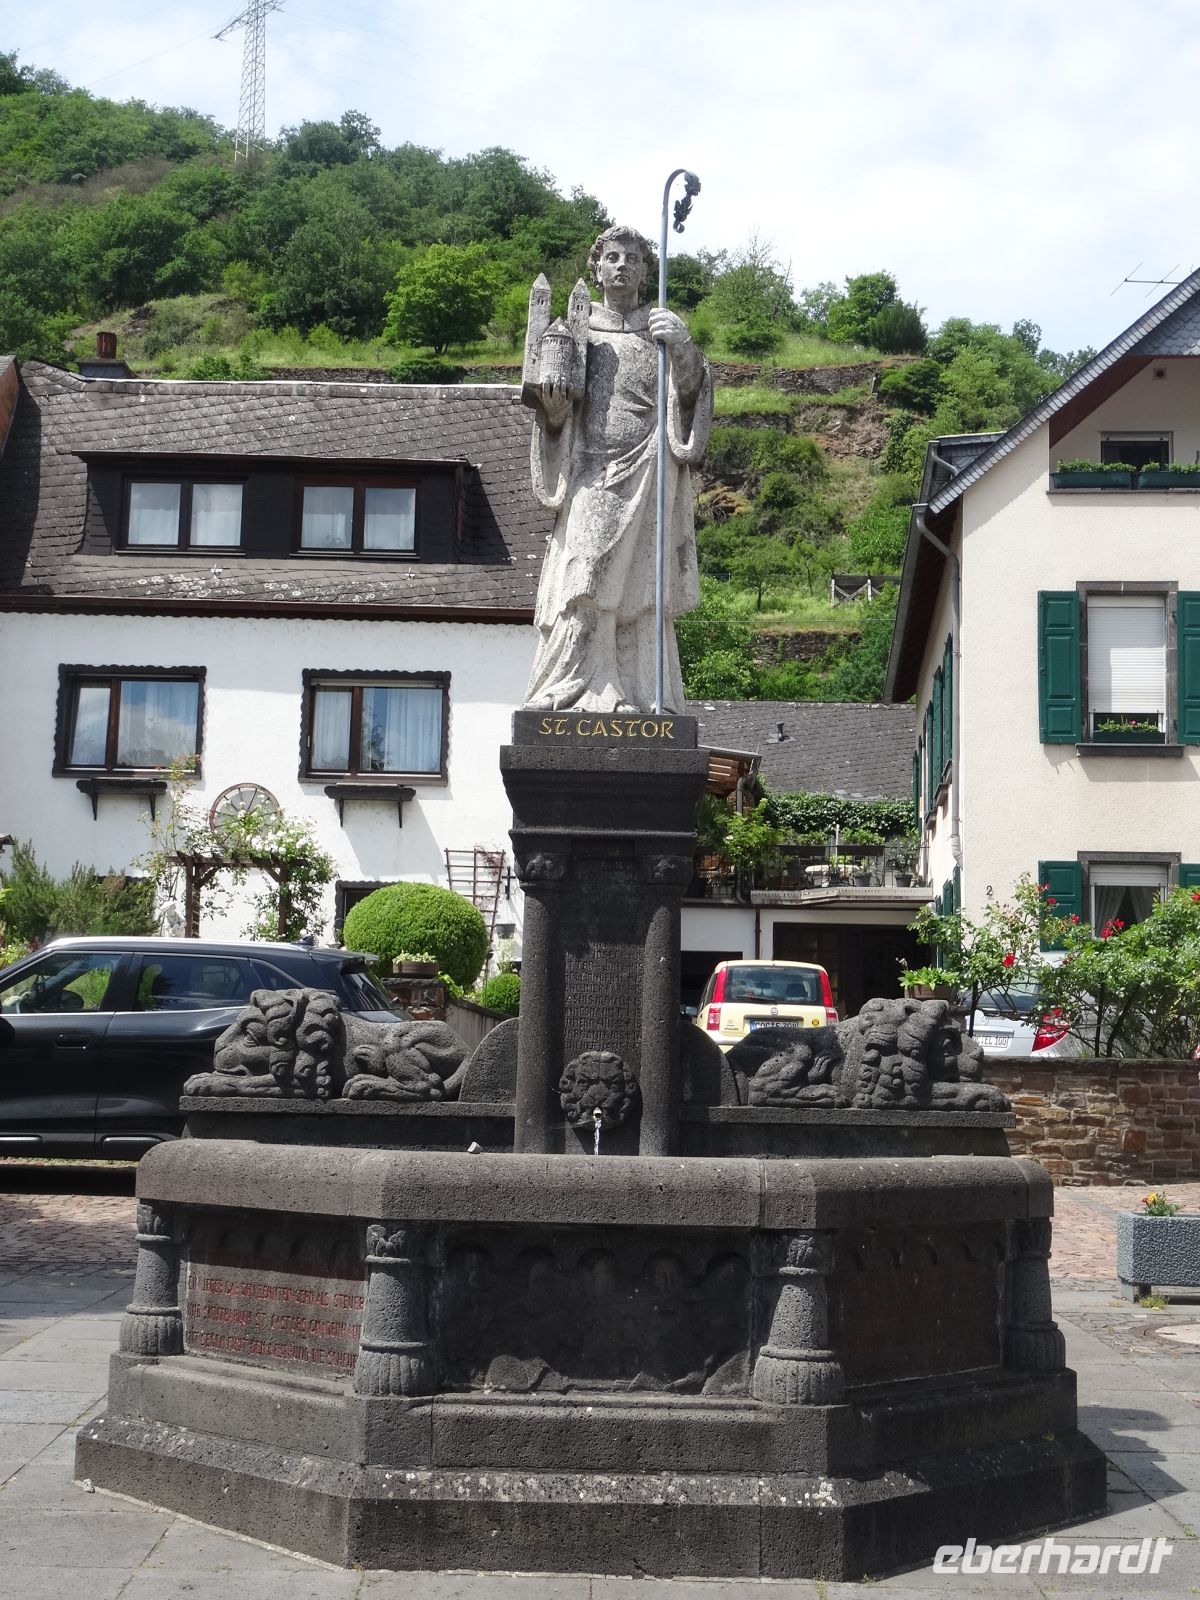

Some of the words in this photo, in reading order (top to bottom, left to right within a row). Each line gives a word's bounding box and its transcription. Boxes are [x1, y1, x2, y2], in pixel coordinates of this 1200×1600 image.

[539, 717, 571, 736] ST.
[576, 718, 675, 739] CASTOR
[985, 884, 993, 897] 2
